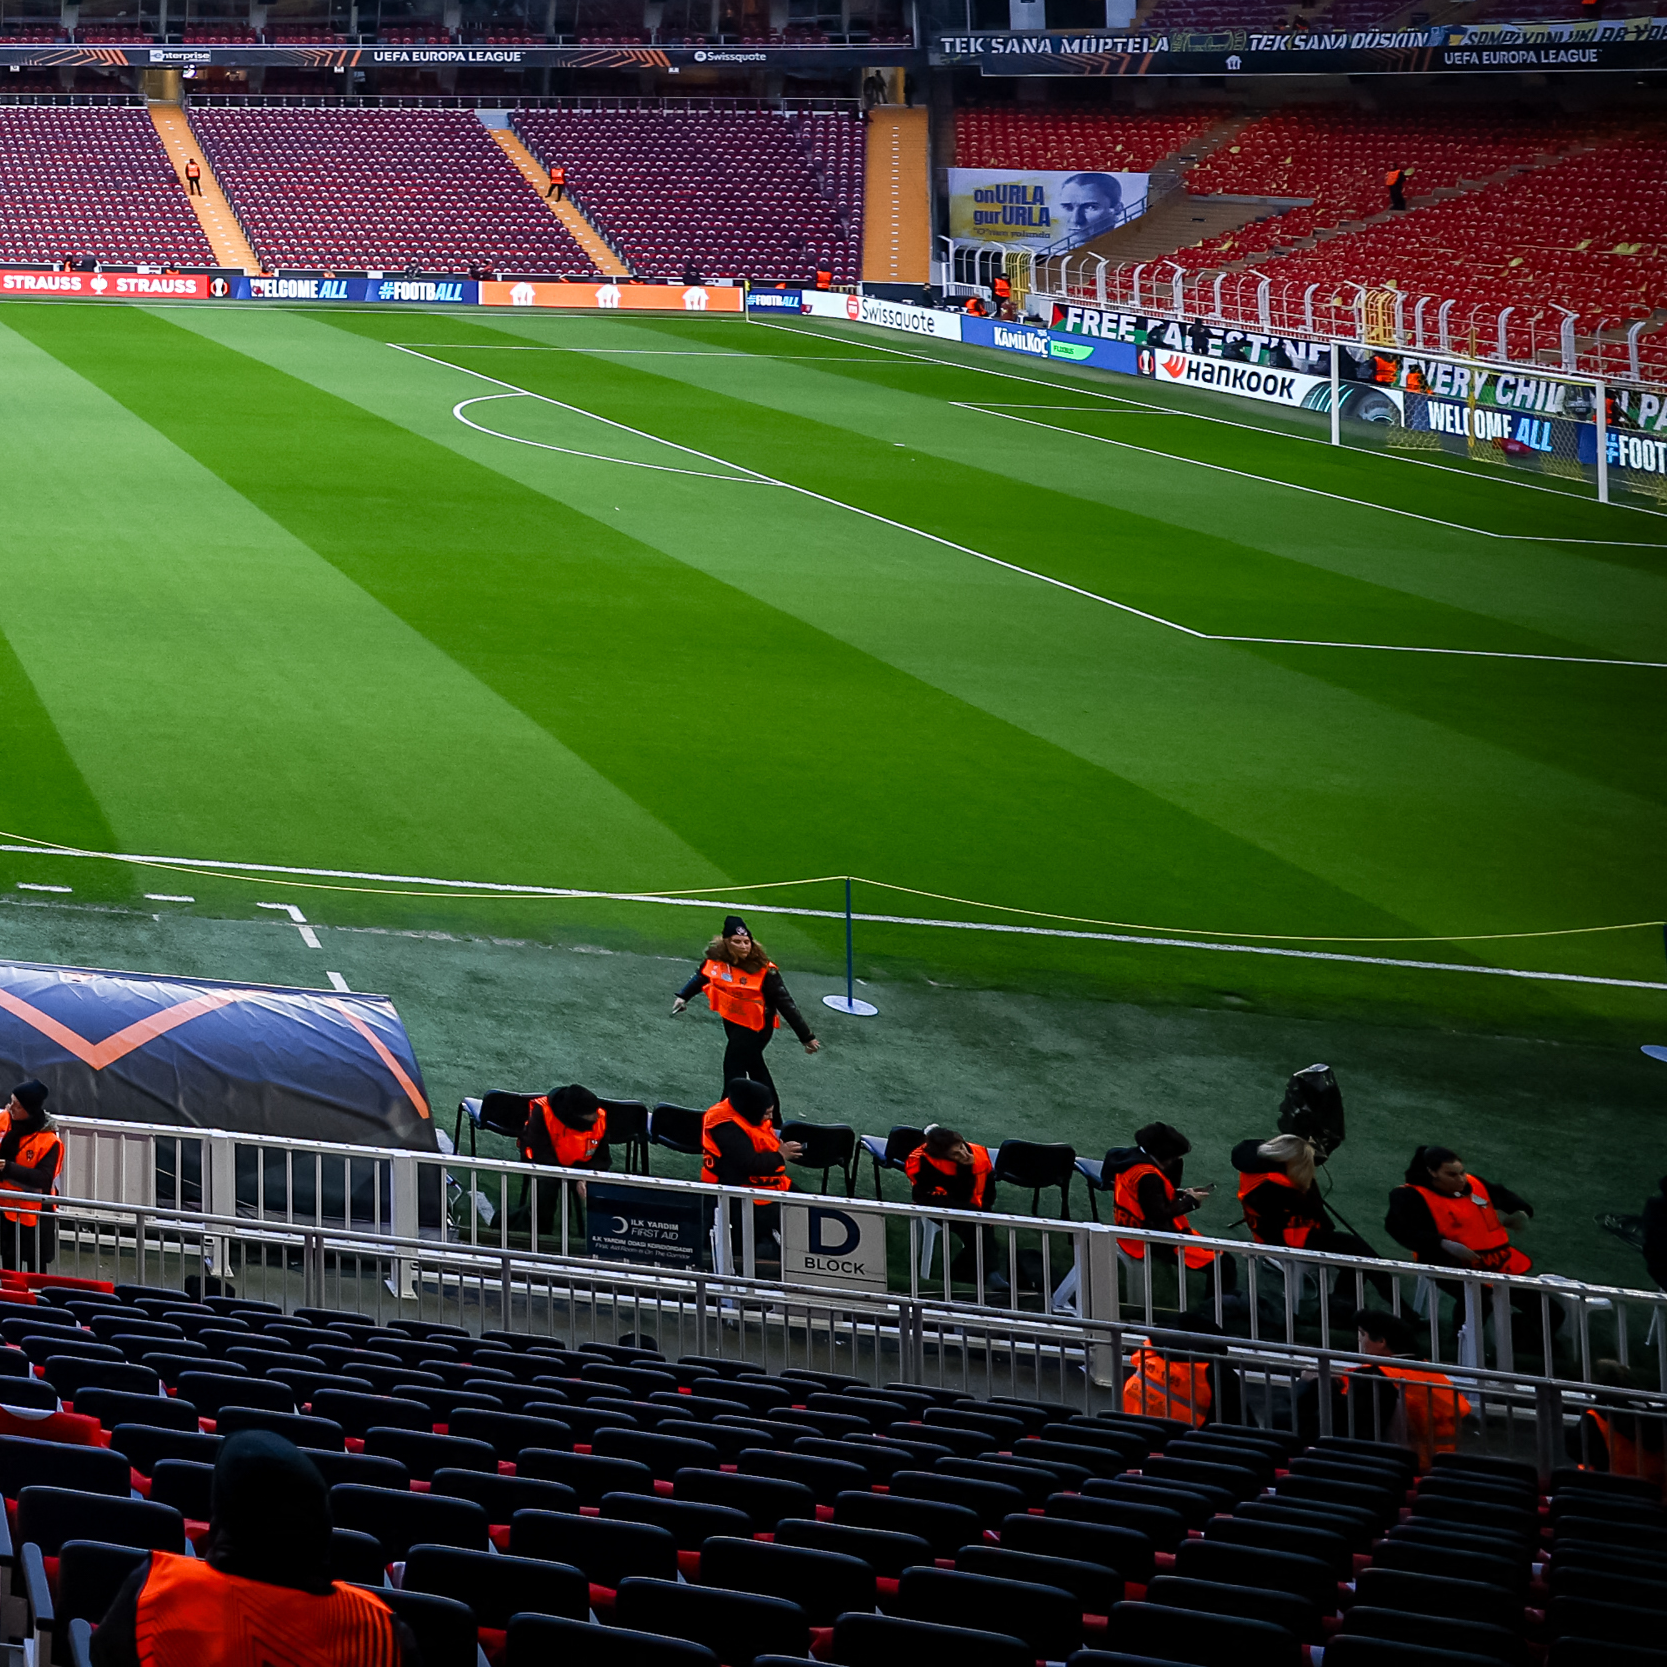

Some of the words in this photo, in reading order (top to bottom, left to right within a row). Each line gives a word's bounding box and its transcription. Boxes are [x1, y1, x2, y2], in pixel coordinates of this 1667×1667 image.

[940, 37, 985, 53] TEK
[991, 37, 1053, 54] SANA
[1249, 33, 1288, 52] TEK
[1293, 32, 1347, 50] SANA
[374, 51, 410, 61] UEFA
[412, 51, 466, 61] EUROPA
[468, 51, 522, 62] LEAGUE
[707, 51, 767, 64] Swissquote
[1444, 50, 1479, 65] UEFA
[1482, 49, 1538, 65] EUROPA
[1540, 48, 1598, 64] LEAGUE
[3, 275, 82, 291] STRAUSS
[116, 277, 197, 295] STRAUSS
[249, 278, 318, 299] WELCOME
[318, 280, 348, 299] ALL
[379, 280, 463, 302] #FOOTBALL
[747, 293, 800, 309] #FOOTBALL
[862, 298, 936, 333] Swissquote
[1066, 307, 1137, 342] FREE
[1427, 400, 1512, 441] WELCOME
[1515, 417, 1553, 452] ALL
[630, 1227, 657, 1238] FIRST
[660, 1231, 679, 1240] AID
[646, 1220, 679, 1231] YARDIM
[808, 1207, 860, 1256] D
[805, 1257, 865, 1275] BLOCK
